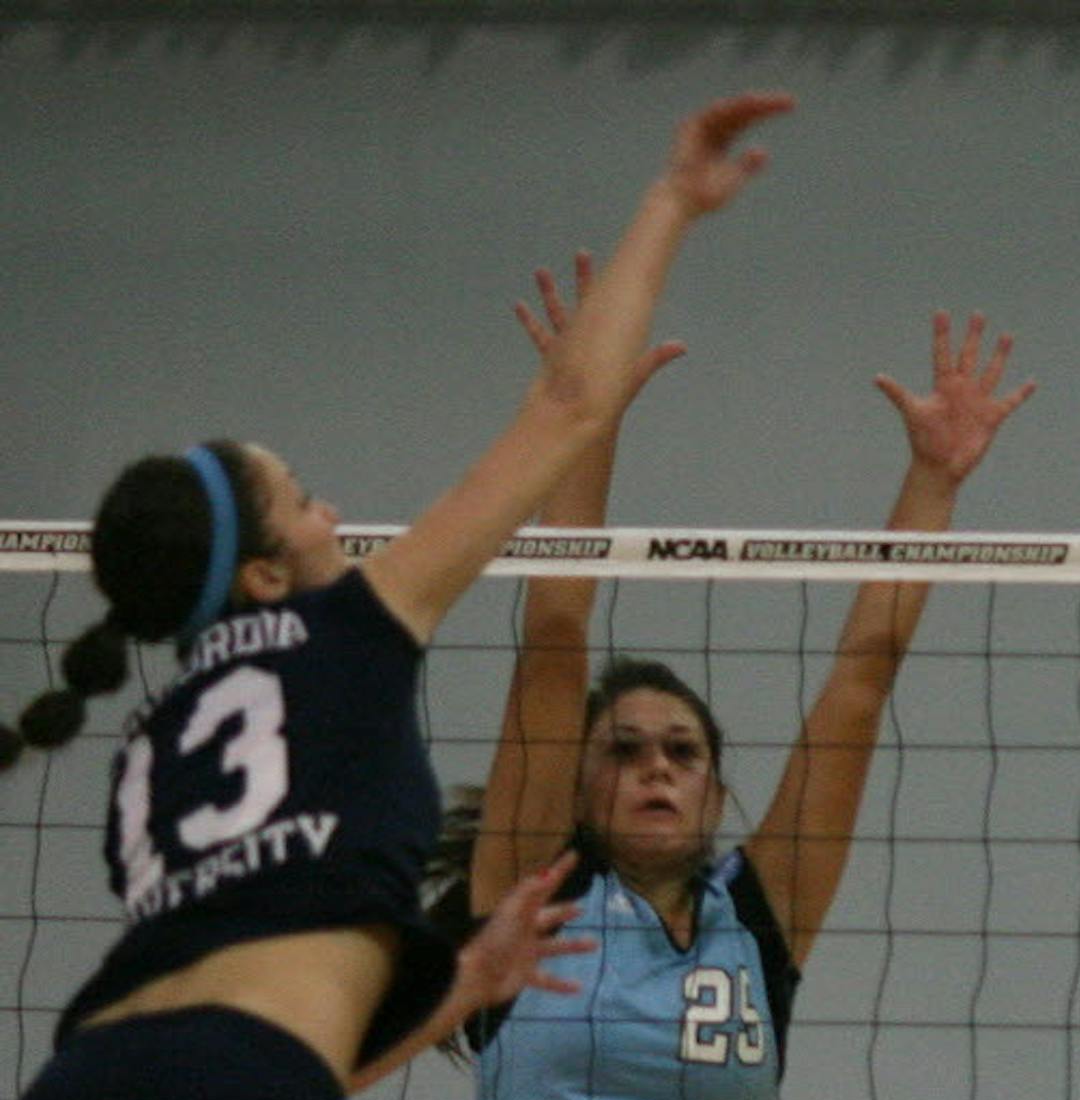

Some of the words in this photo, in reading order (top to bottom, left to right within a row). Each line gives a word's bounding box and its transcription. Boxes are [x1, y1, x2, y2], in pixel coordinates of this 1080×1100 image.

[648, 538, 728, 560] NCAA
[746, 540, 883, 562] VOLLEYBALL
[889, 542, 1066, 563] CHAMPIONSHIP
[116, 664, 291, 905] 13
[679, 966, 766, 1066] 25
